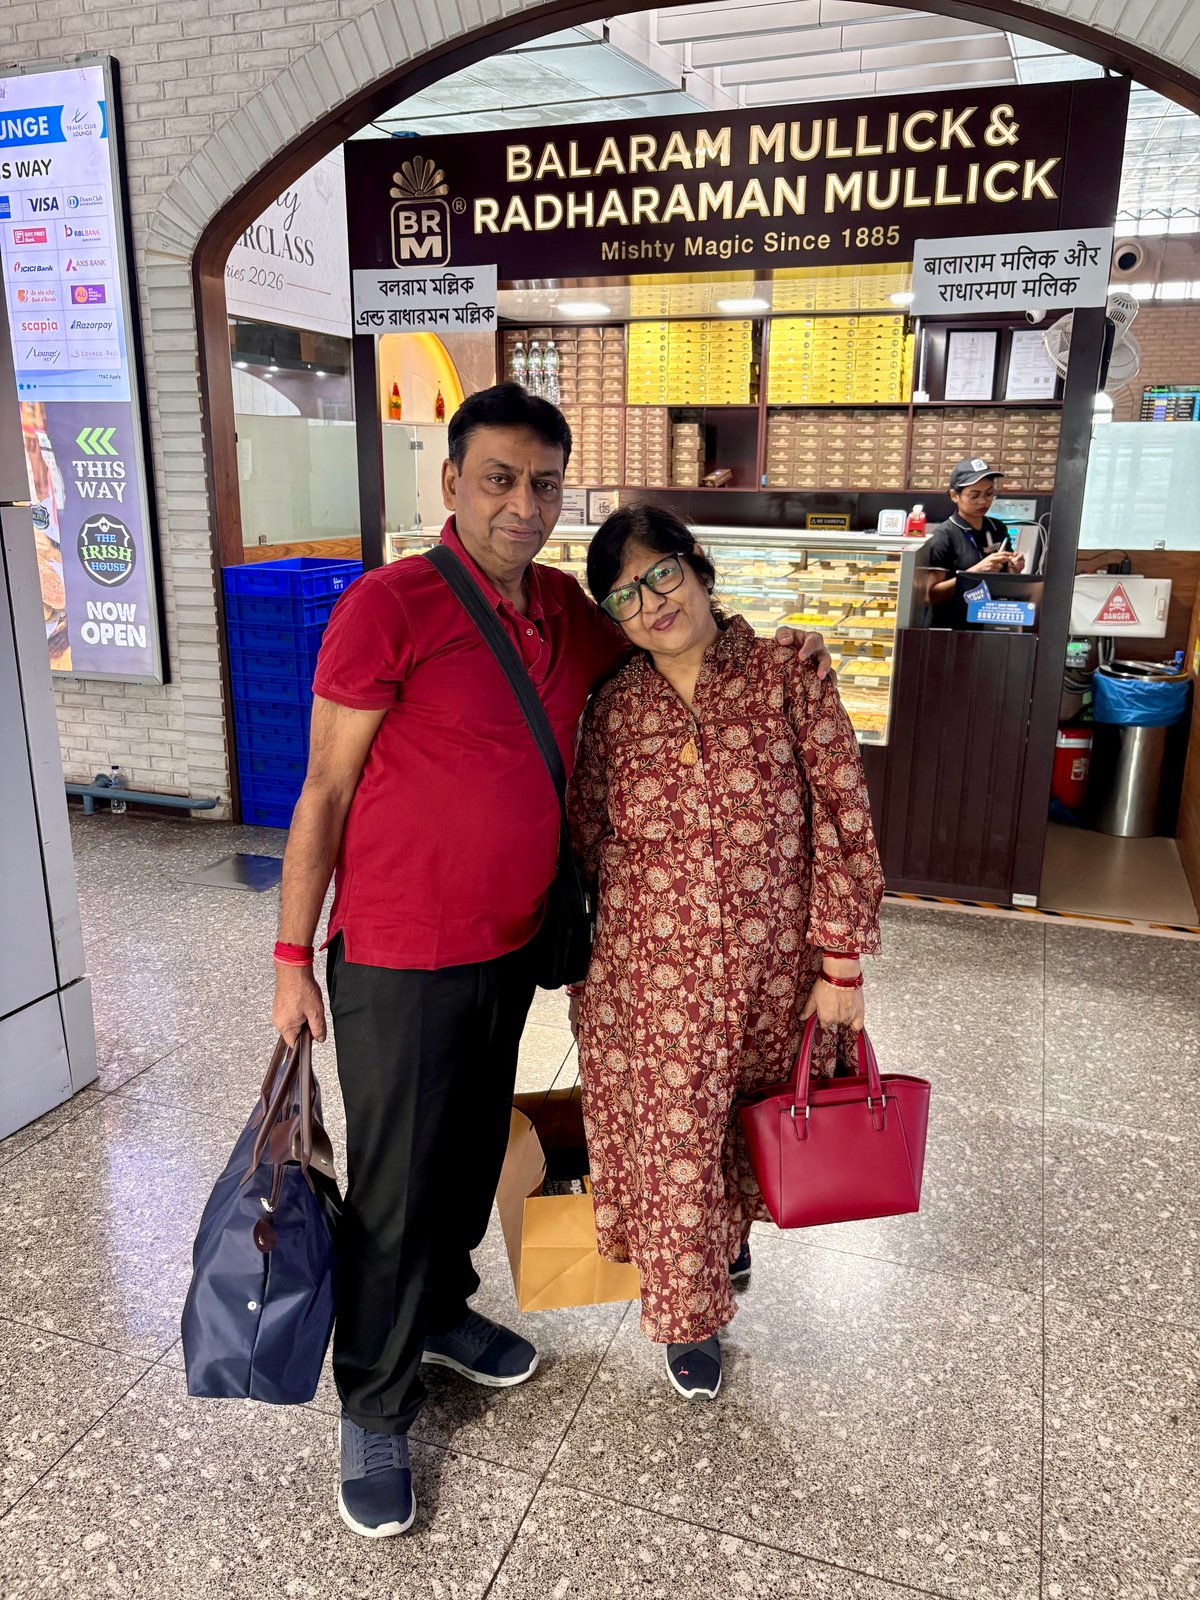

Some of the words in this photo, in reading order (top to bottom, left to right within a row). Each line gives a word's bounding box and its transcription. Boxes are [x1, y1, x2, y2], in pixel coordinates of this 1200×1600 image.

[506, 126, 732, 182] BALARAM
[748, 106, 978, 165] MULLICK
[983, 103, 1020, 148] &
[0, 162, 12, 180] S
[15, 158, 52, 179] WAY
[27, 196, 60, 212] VISA
[472, 175, 808, 234] RADHARAMAN
[824, 157, 1062, 213] MULLICK
[399, 209, 441, 235] BR
[235, 224, 315, 267] RCLASS
[400, 235, 443, 260] M
[601, 238, 675, 262] Mishty
[684, 234, 754, 259] Magic
[763, 231, 831, 253] Since
[841, 225, 900, 248] 1885
[20, 265, 36, 273] ICICI
[36, 264, 53, 273] Bank
[76, 259, 89, 267] AXIS
[89, 258, 106, 267] BANK
[923, 253, 996, 276] बालाराम
[1000, 245, 1059, 271] मलिक
[1063, 239, 1102, 267] और
[248, 266, 284, 291] 2026
[377, 279, 428, 297] বলরাম
[429, 272, 475, 296] মল্লিক
[938, 279, 1018, 302] राधारमण
[1021, 272, 1081, 298] मलिक
[386, 307, 451, 326] রাধারমন
[452, 301, 496, 324] মল্লিক
[21, 317, 58, 334] scapia
[76, 320, 113, 331] Razorpay
[33, 348, 57, 358] Lounge
[72, 460, 126, 479] THIS
[75, 480, 127, 504] WAY
[95, 533, 117, 543] THE
[80, 545, 133, 563] IRISH
[91, 562, 127, 572] HOUSE
[86, 600, 137, 623] NOW
[1103, 612, 1131, 621] DANGER
[81, 622, 147, 648] OPEN
